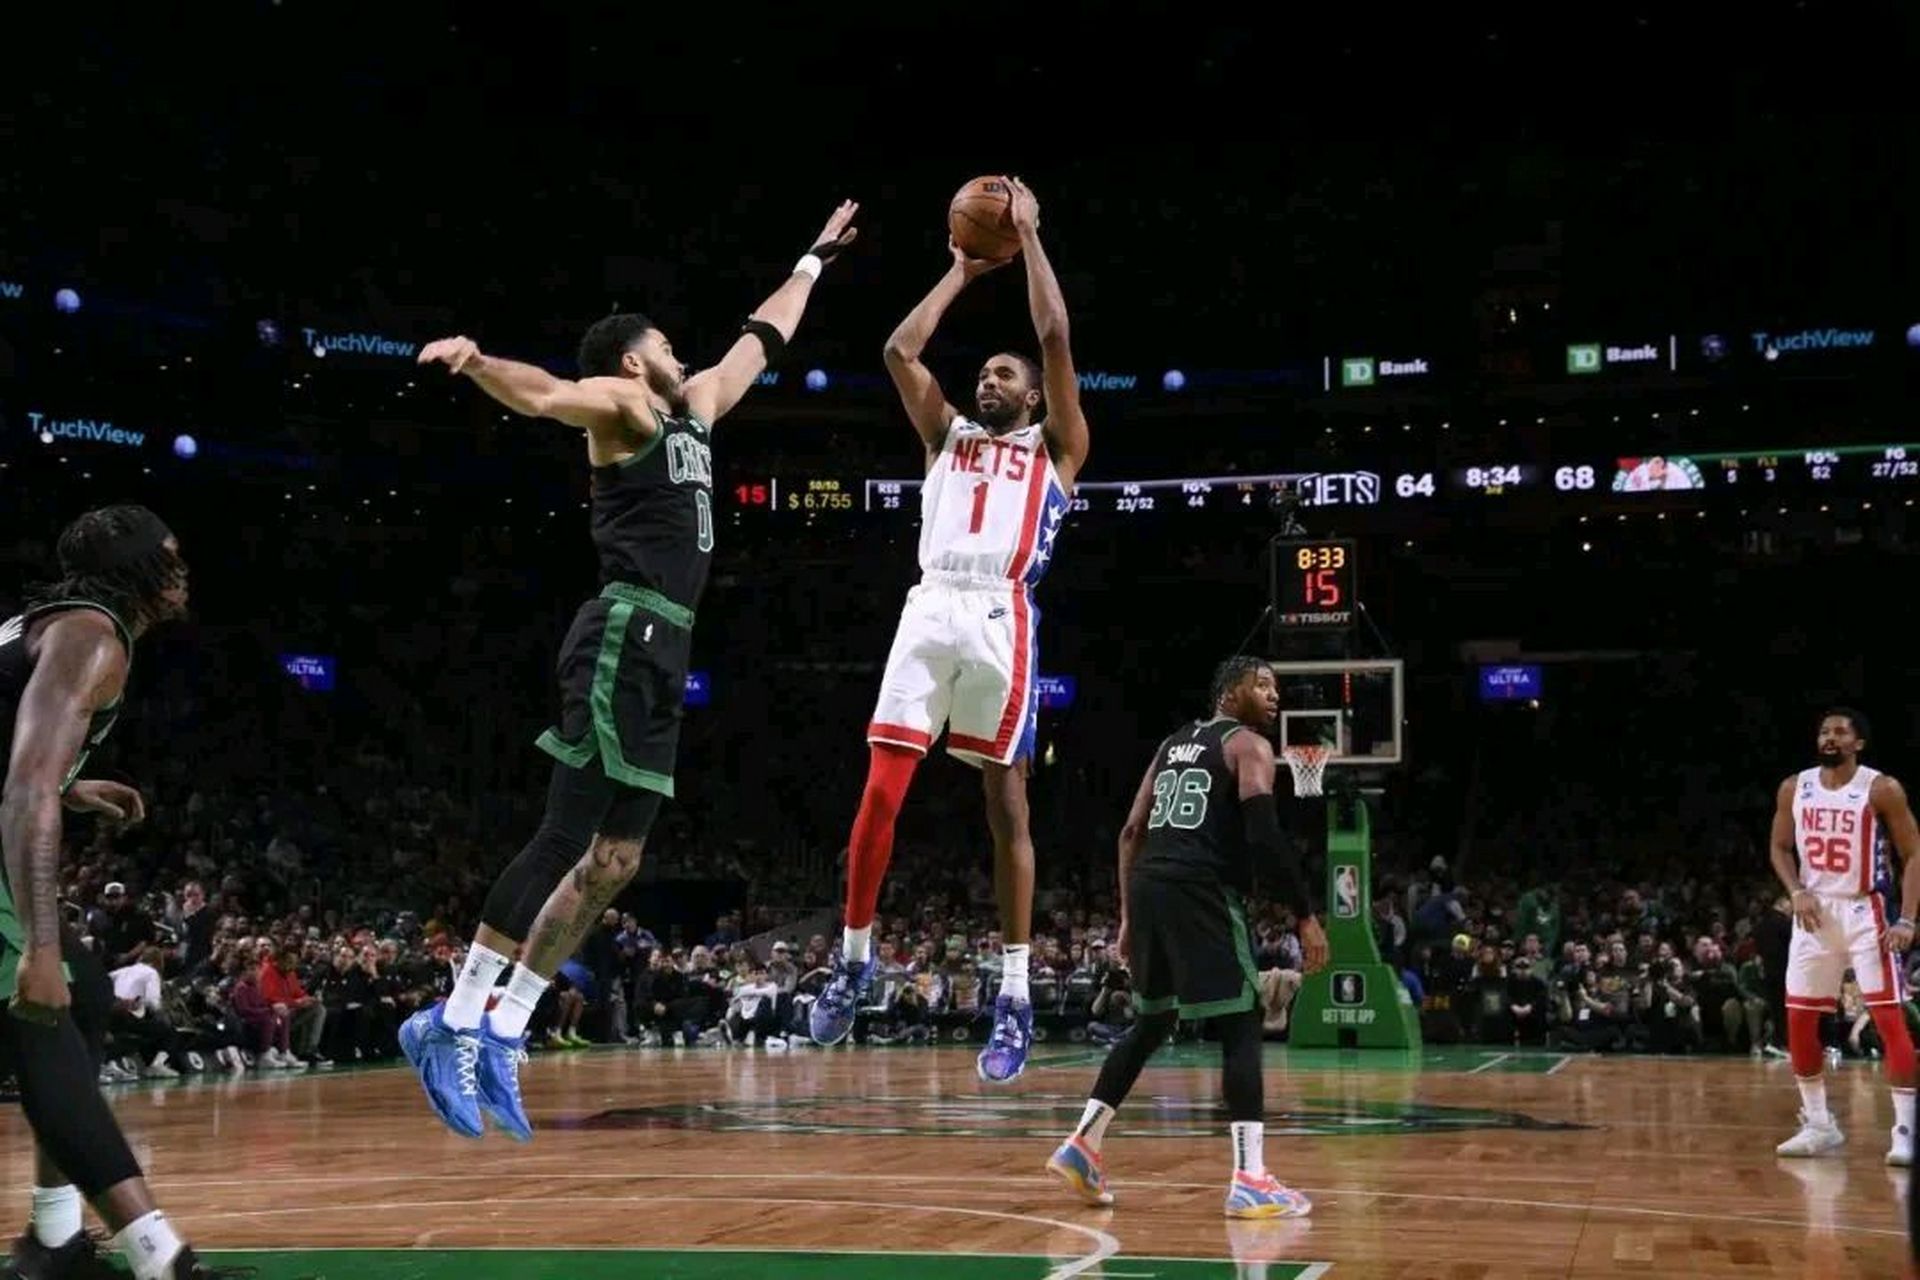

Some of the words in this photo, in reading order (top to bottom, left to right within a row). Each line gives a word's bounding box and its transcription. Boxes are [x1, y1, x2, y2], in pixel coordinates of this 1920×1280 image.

[301, 328, 415, 357] TuchView
[1751, 327, 1874, 359] TuchView
[1570, 349, 1597, 368] TD
[1606, 344, 1657, 362] Bank
[1346, 363, 1371, 380] TD
[1380, 359, 1428, 375] Bank
[28, 412, 144, 446] TuchView
[951, 438, 1030, 482] NETS
[1872, 461, 1918, 479] 27/52
[1466, 464, 1521, 487] 8:34
[1555, 465, 1595, 491] 68
[1765, 468, 1775, 481] 3
[1812, 465, 1831, 479] 52
[735, 485, 765, 503] 15
[1396, 473, 1436, 498] 64
[788, 493, 800, 510] $
[883, 496, 899, 508] 25
[969, 481, 989, 534] 1
[1116, 498, 1154, 513] 23/52
[1188, 495, 1204, 507] 44
[1242, 493, 1251, 505] 4
[694, 489, 714, 553] 0
[1298, 547, 1345, 570] 8:33
[1306, 570, 1339, 605] 15
[1488, 673, 1530, 685] ULTRA
[1167, 743, 1207, 766] SMART
[1148, 768, 1212, 830] 36
[1802, 806, 1856, 834] NETS
[1804, 836, 1852, 875] 26
